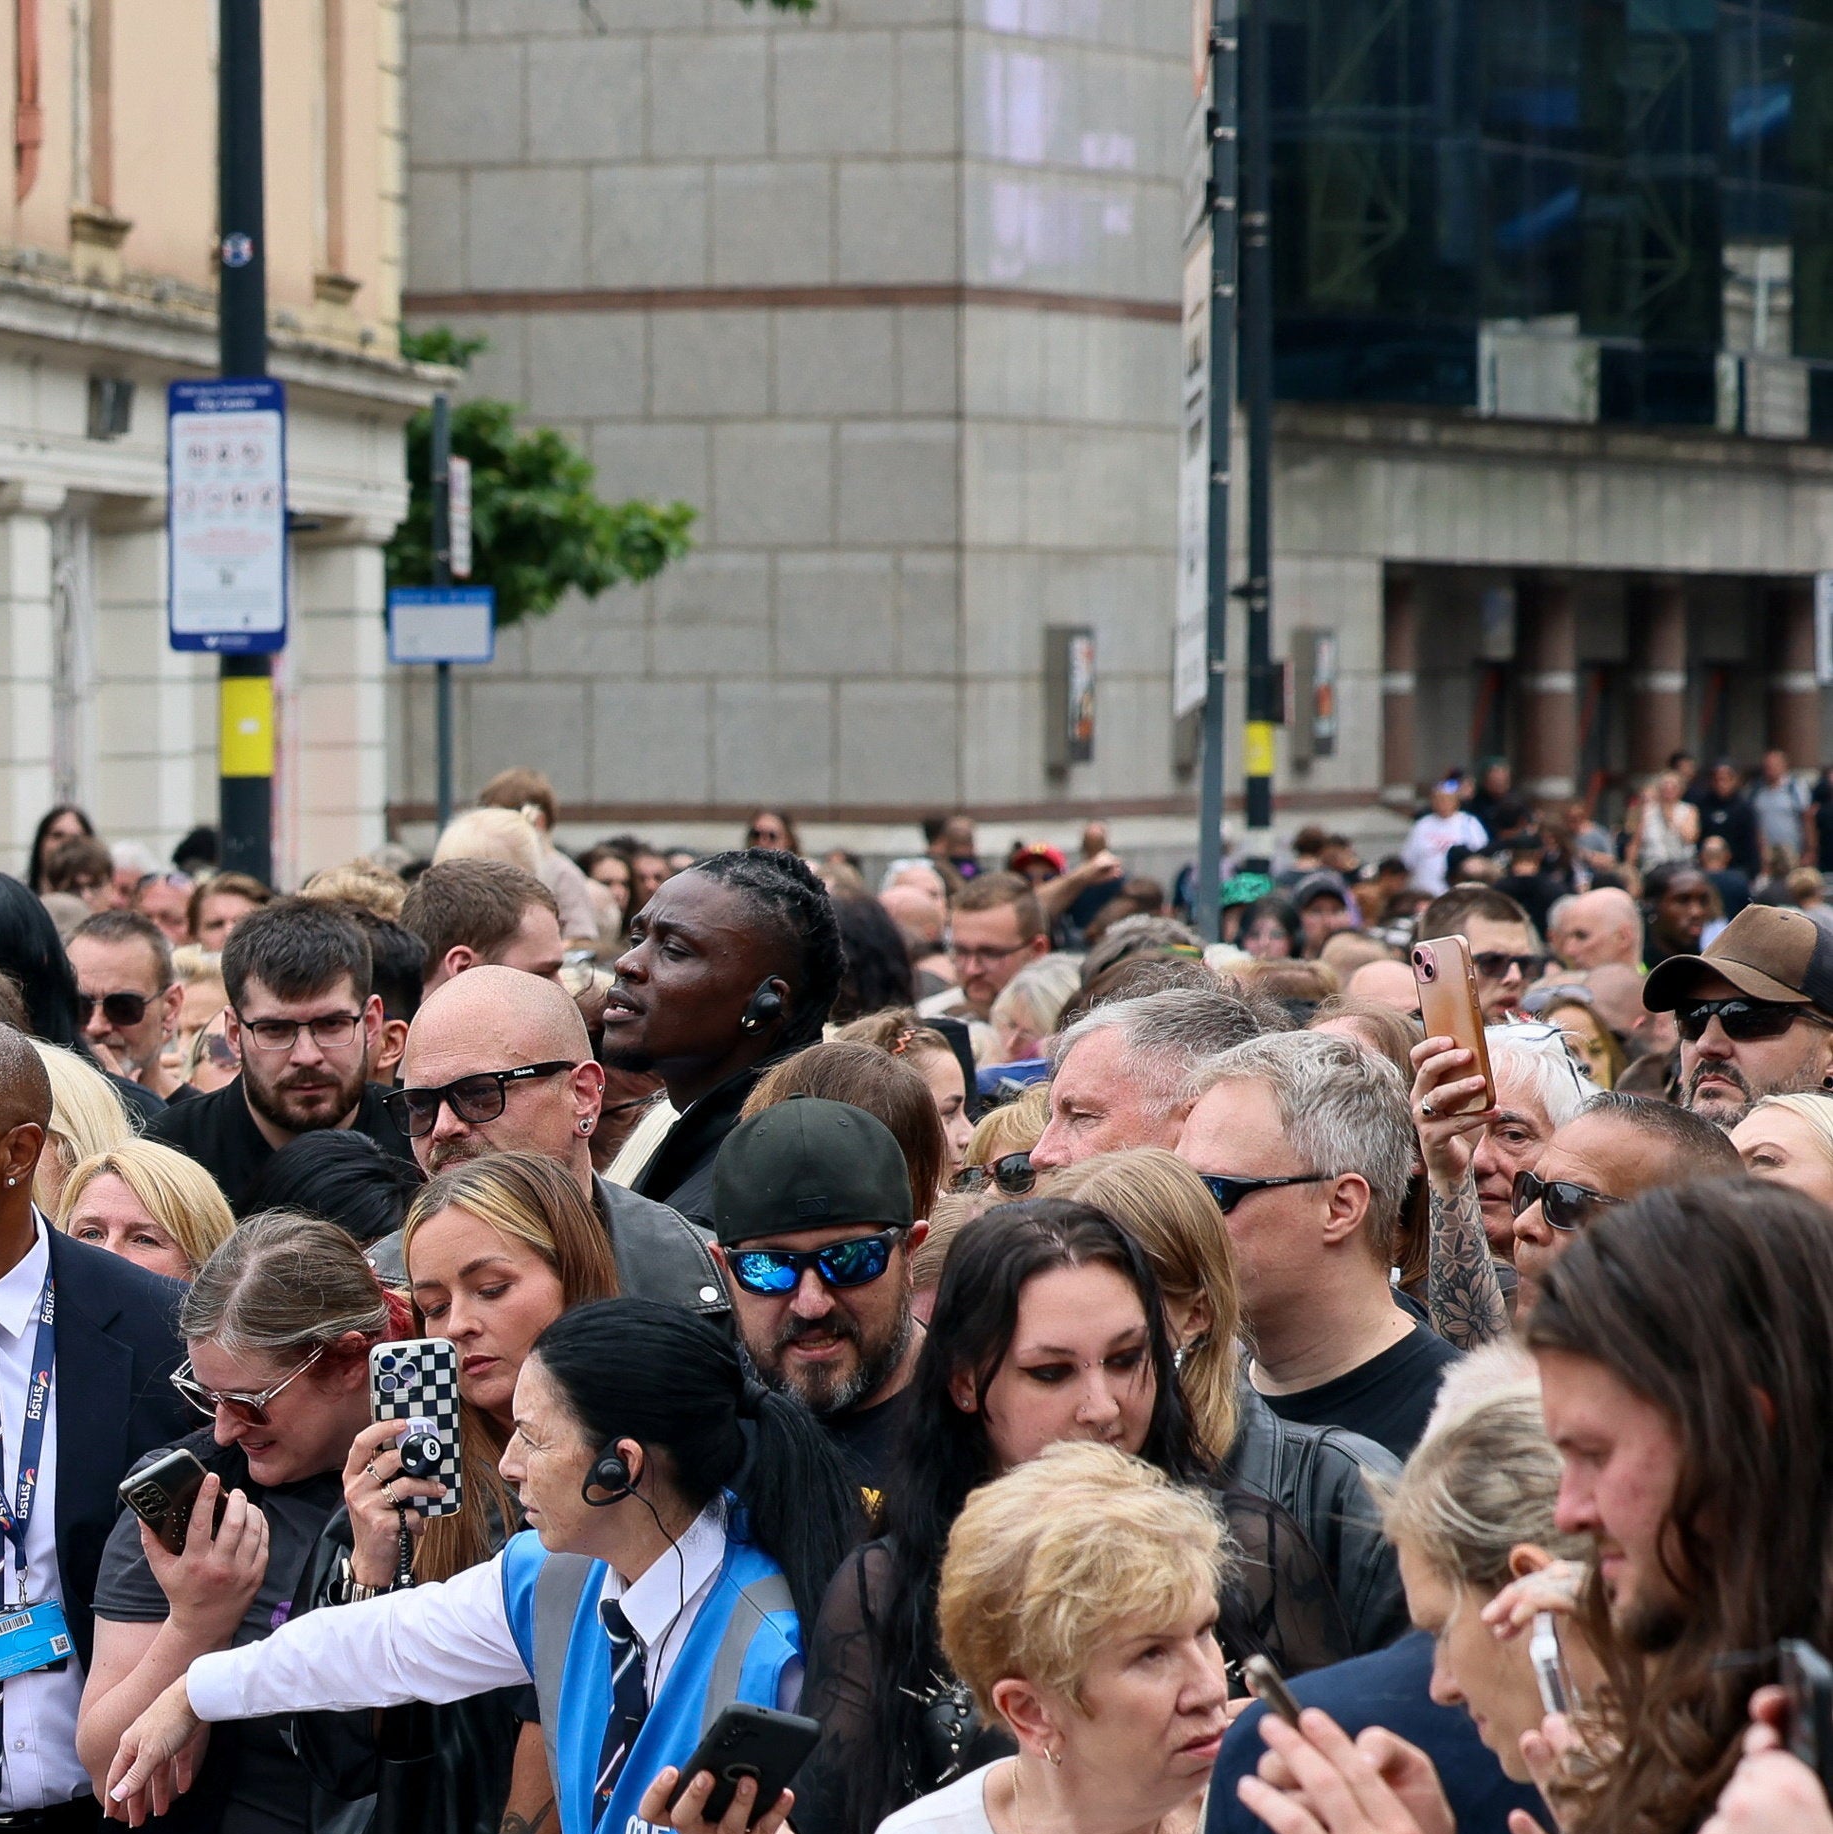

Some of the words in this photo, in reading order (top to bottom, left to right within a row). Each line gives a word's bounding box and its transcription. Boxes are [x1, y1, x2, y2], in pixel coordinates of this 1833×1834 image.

[41, 1288, 56, 1326] snsg
[26, 1382, 45, 1422] snsg
[17, 1482, 32, 1521] snsg
